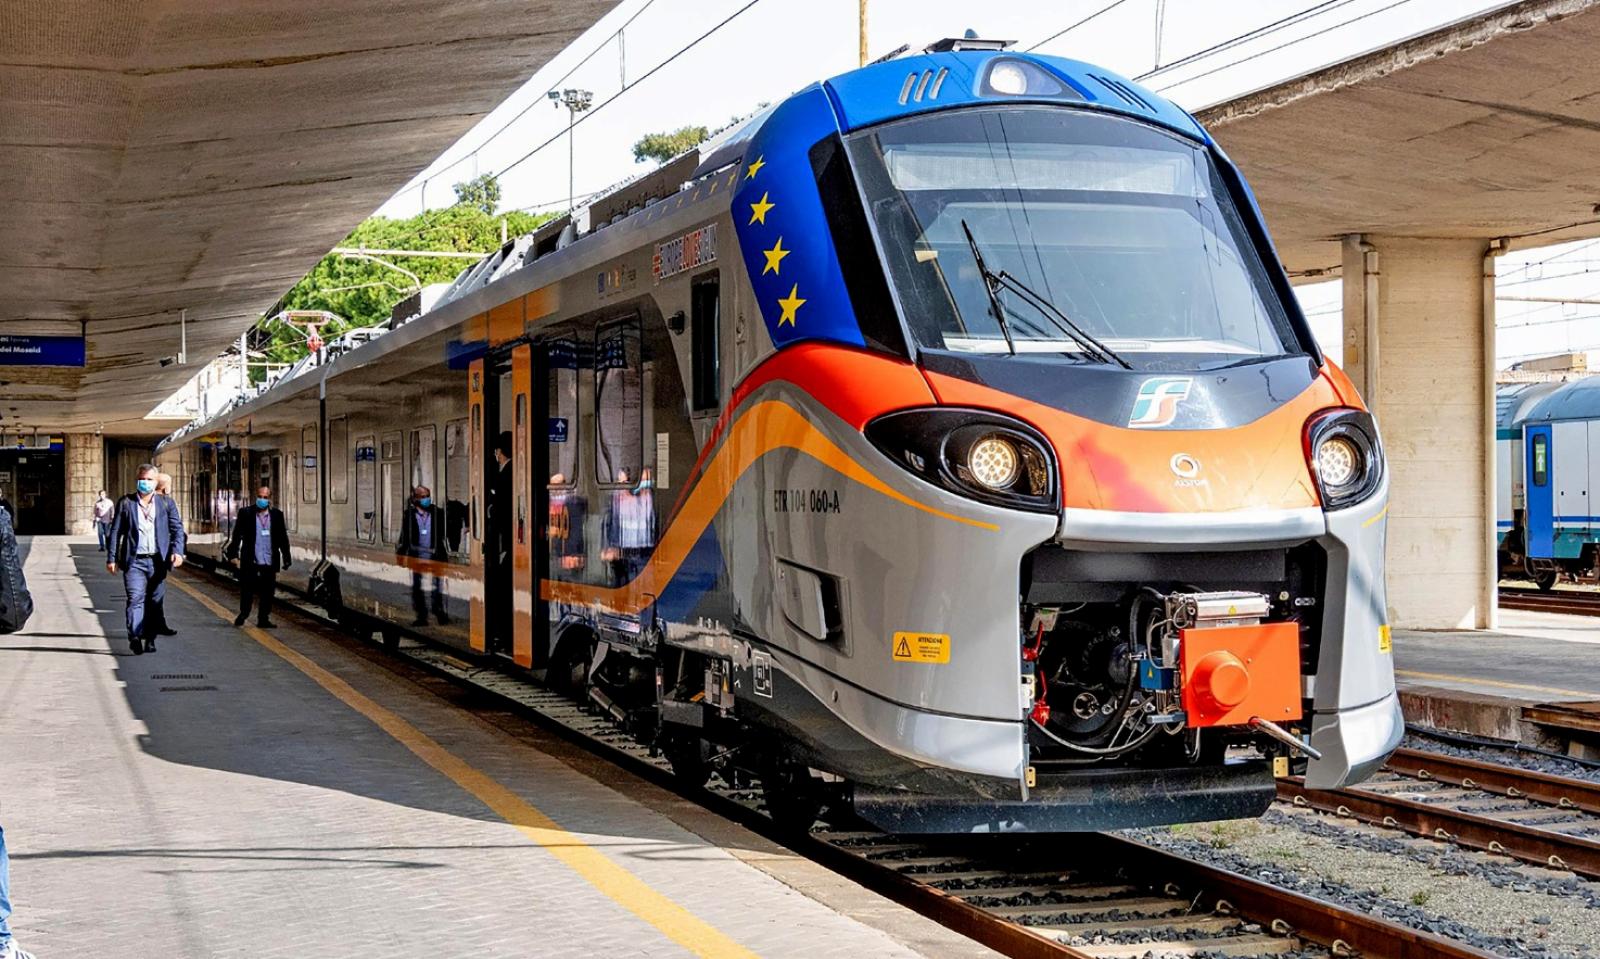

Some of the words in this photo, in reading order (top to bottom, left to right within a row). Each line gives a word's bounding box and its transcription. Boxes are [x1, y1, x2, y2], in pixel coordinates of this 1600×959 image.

[774, 489, 788, 513] ETR
[790, 489, 806, 513] 104
[810, 489, 841, 514] 060-A
